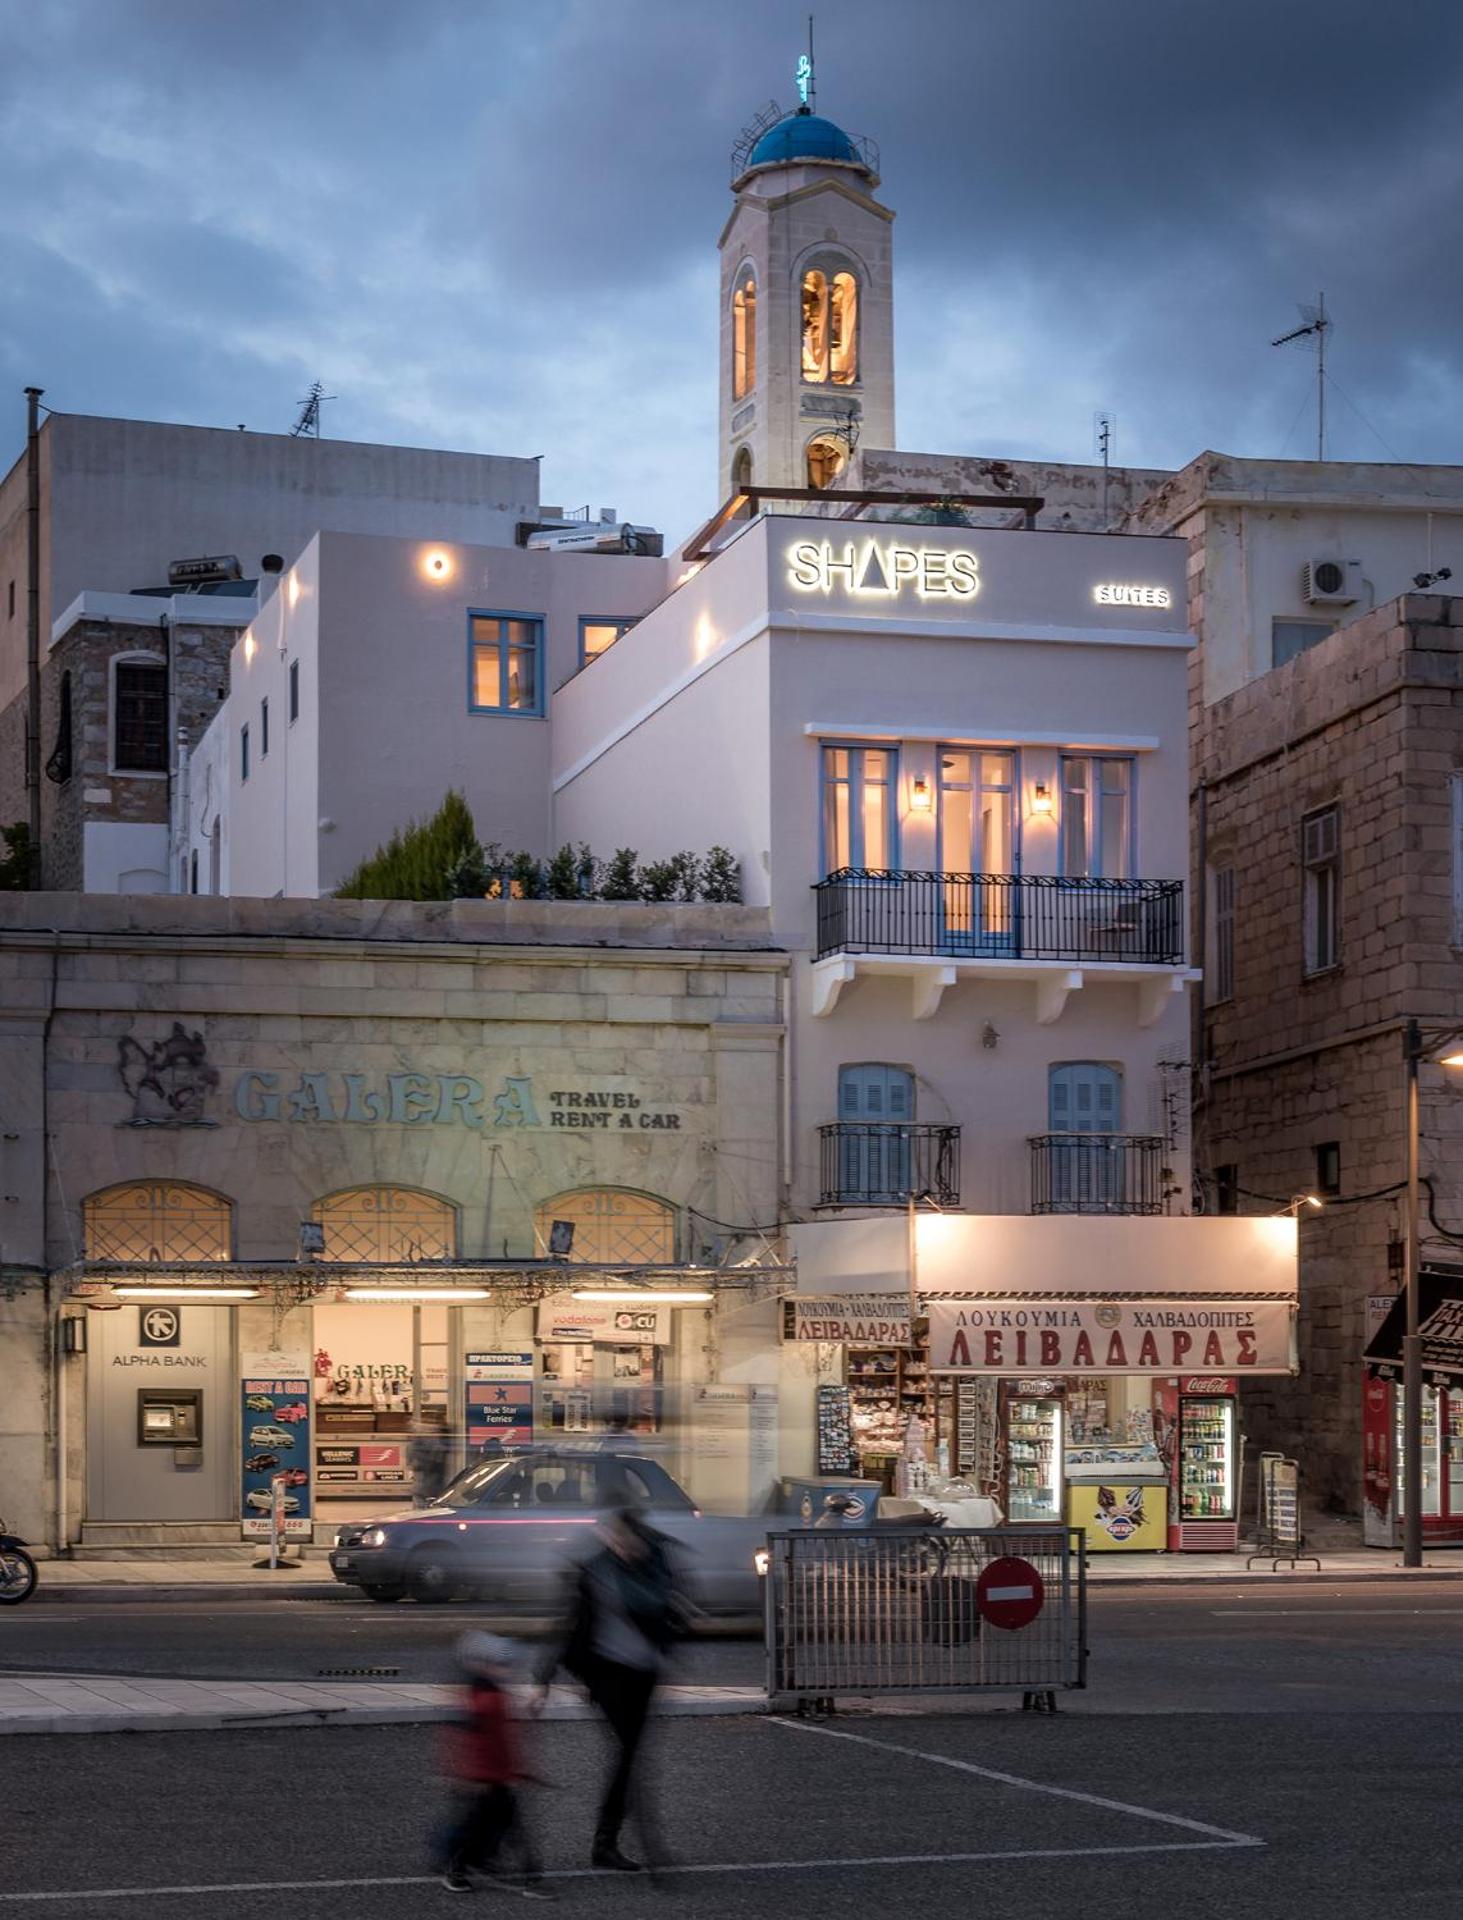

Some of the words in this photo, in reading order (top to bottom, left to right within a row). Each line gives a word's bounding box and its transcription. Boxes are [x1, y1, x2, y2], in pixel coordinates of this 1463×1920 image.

[794, 544, 978, 595] SHAPES
[1099, 585, 1170, 606] SUITES
[233, 1072, 541, 1127] GALERA
[550, 1091, 641, 1109] TRAVEL
[551, 1111, 612, 1128] RENT
[619, 1113, 633, 1128] A
[639, 1113, 681, 1129] CAR
[554, 1315, 606, 1325] vodafone
[956, 1310, 1082, 1327] ΛΟΥΚΟΥΜΙΑ
[1133, 1312, 1255, 1327] ΧΑΛΒΑΔΟΠΙΤΕΣ
[799, 1321, 909, 1342] ΛΕΙΒΑΔΑΡΑΣ
[949, 1329, 1258, 1366] ΛΕΙΒΑΔΑΡΑΣ
[113, 1355, 161, 1366] ALPHA
[164, 1356, 207, 1367] BANK
[1187, 1377, 1228, 1393] Coca-Cola
[483, 1406, 500, 1414] Blue
[502, 1406, 517, 1414] Star
[486, 1415, 513, 1423] Ferries
